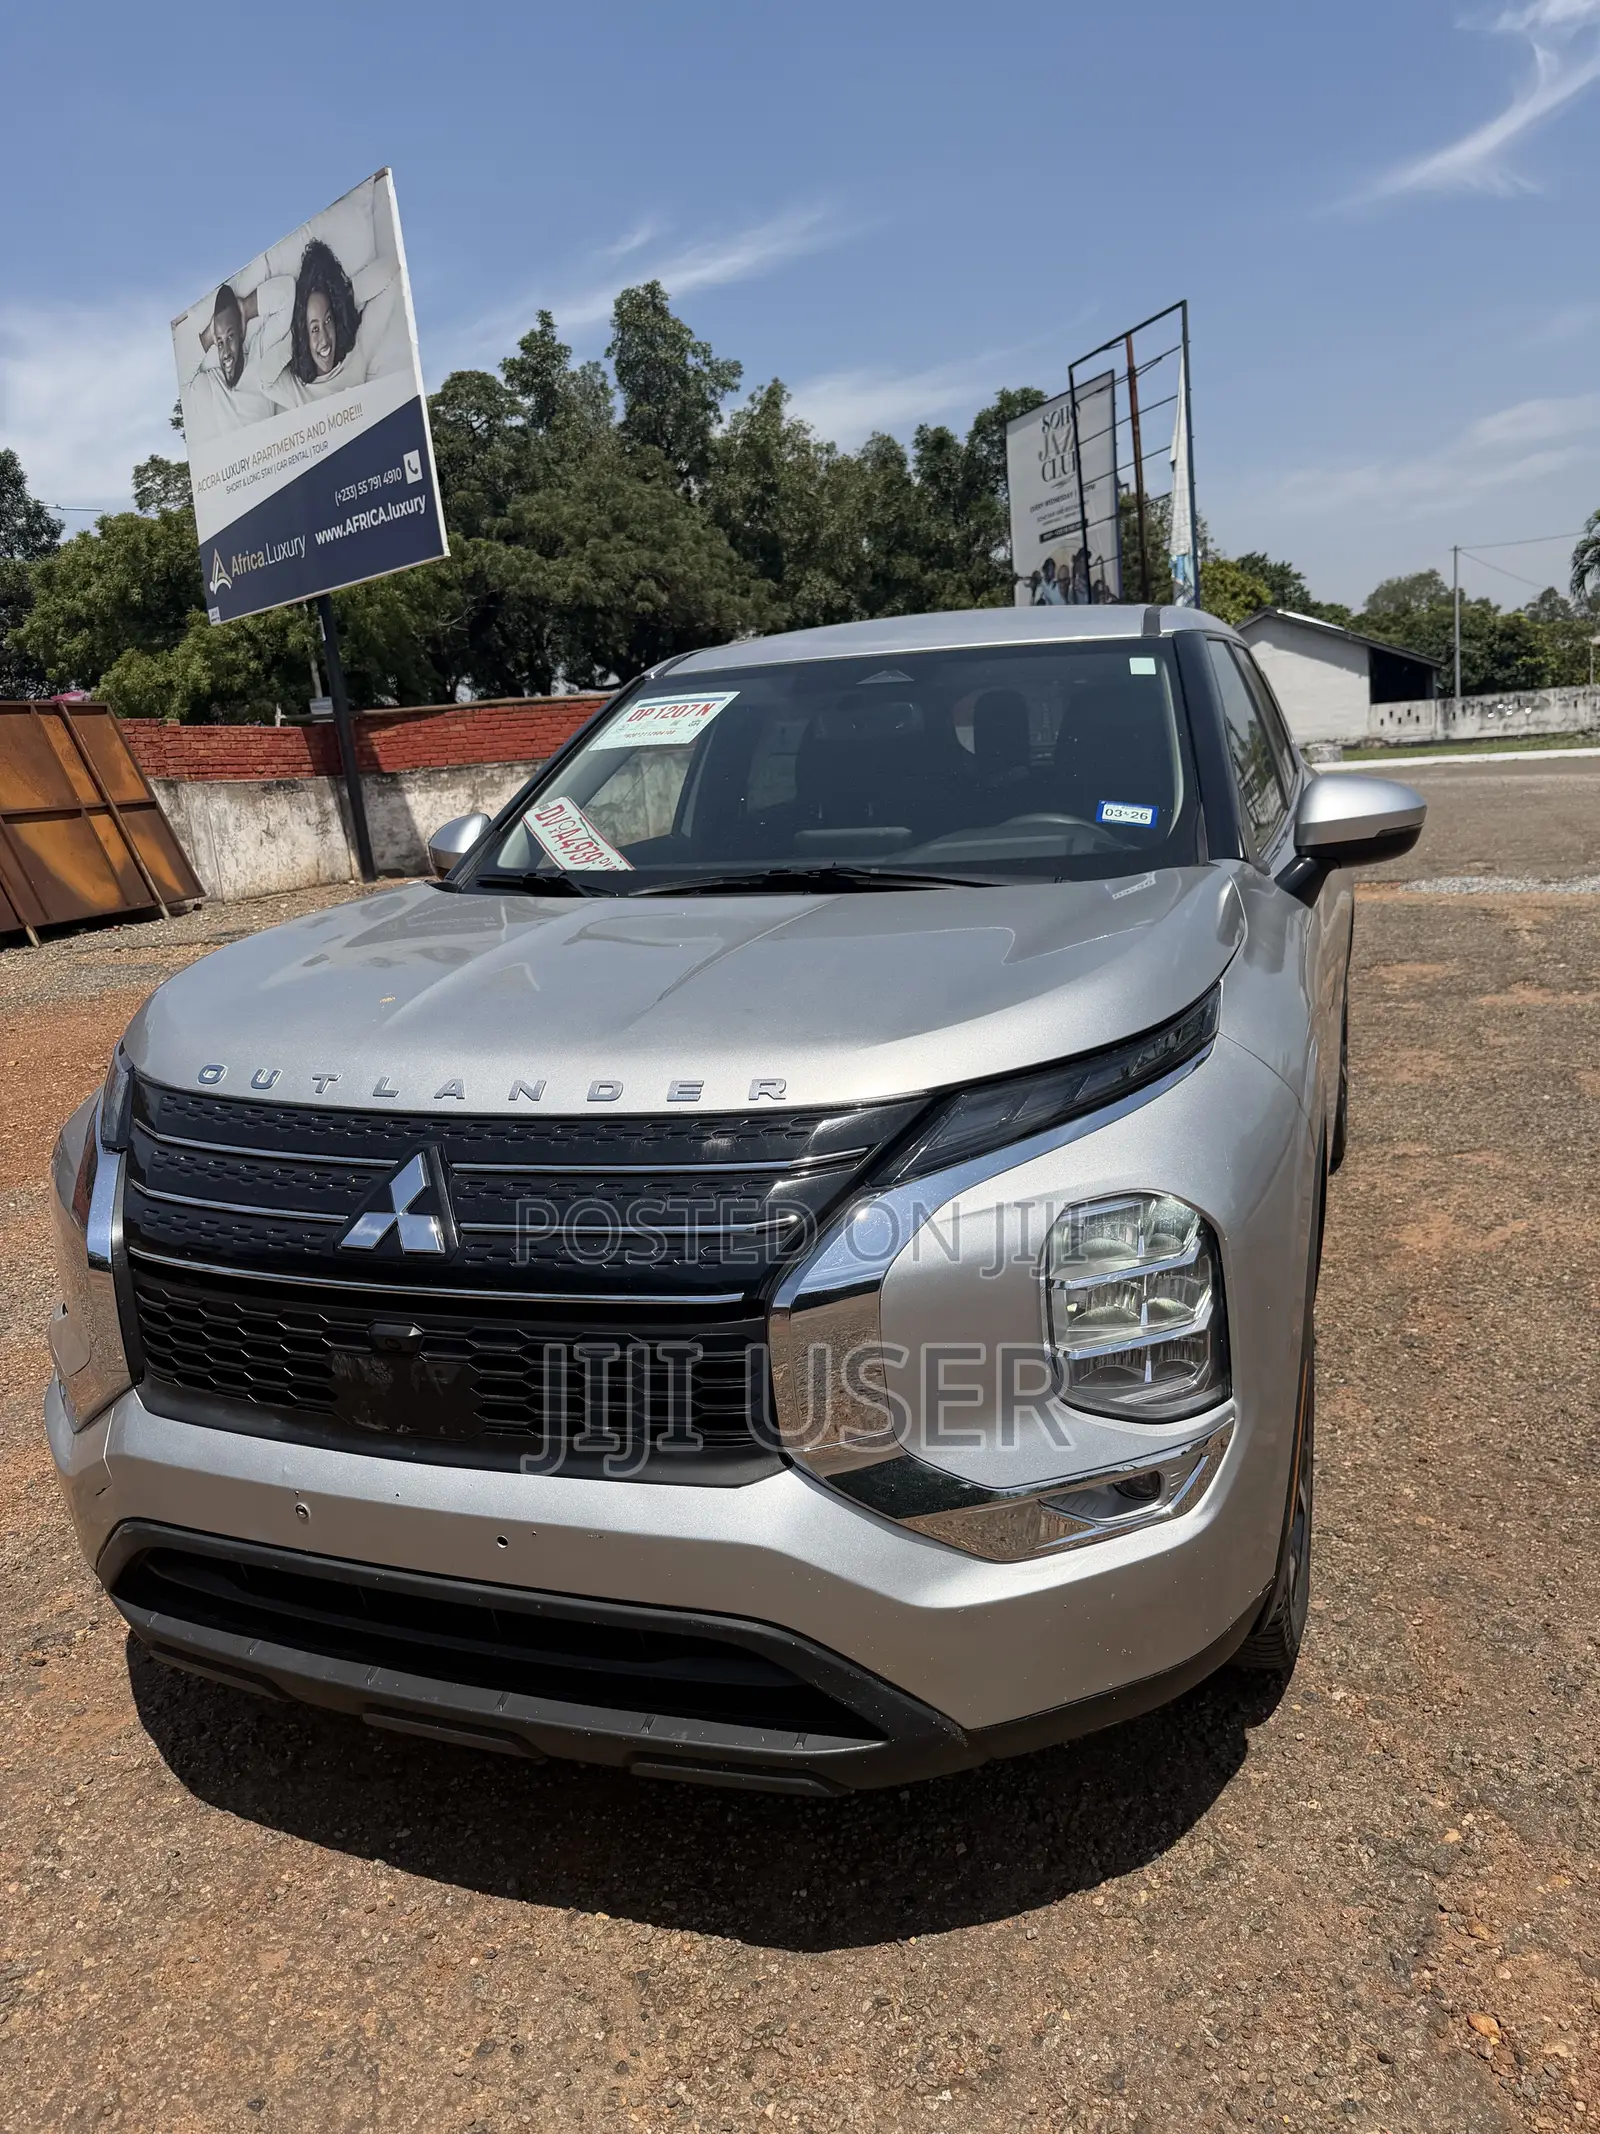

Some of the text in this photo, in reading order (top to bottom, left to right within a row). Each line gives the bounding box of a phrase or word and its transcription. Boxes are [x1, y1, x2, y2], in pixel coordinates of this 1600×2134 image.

[197, 402, 363, 494] ACCRA LUXURY APARTMENTS AND MORE!!!
[225, 479, 243, 495] SHORT
[247, 471, 261, 486] LONG
[260, 465, 275, 481] STAY
[276, 459, 288, 475] CAR
[288, 450, 310, 468] RENTAL
[312, 440, 329, 456] TOUR
[1041, 451, 1077, 482] CLU
[335, 467, 402, 507] (+233) 55 791 4910
[315, 494, 426, 545] www.AFRICA.luxury
[627, 702, 716, 723] DP 1207 N
[197, 1064, 788, 1102] OUTLANDER
